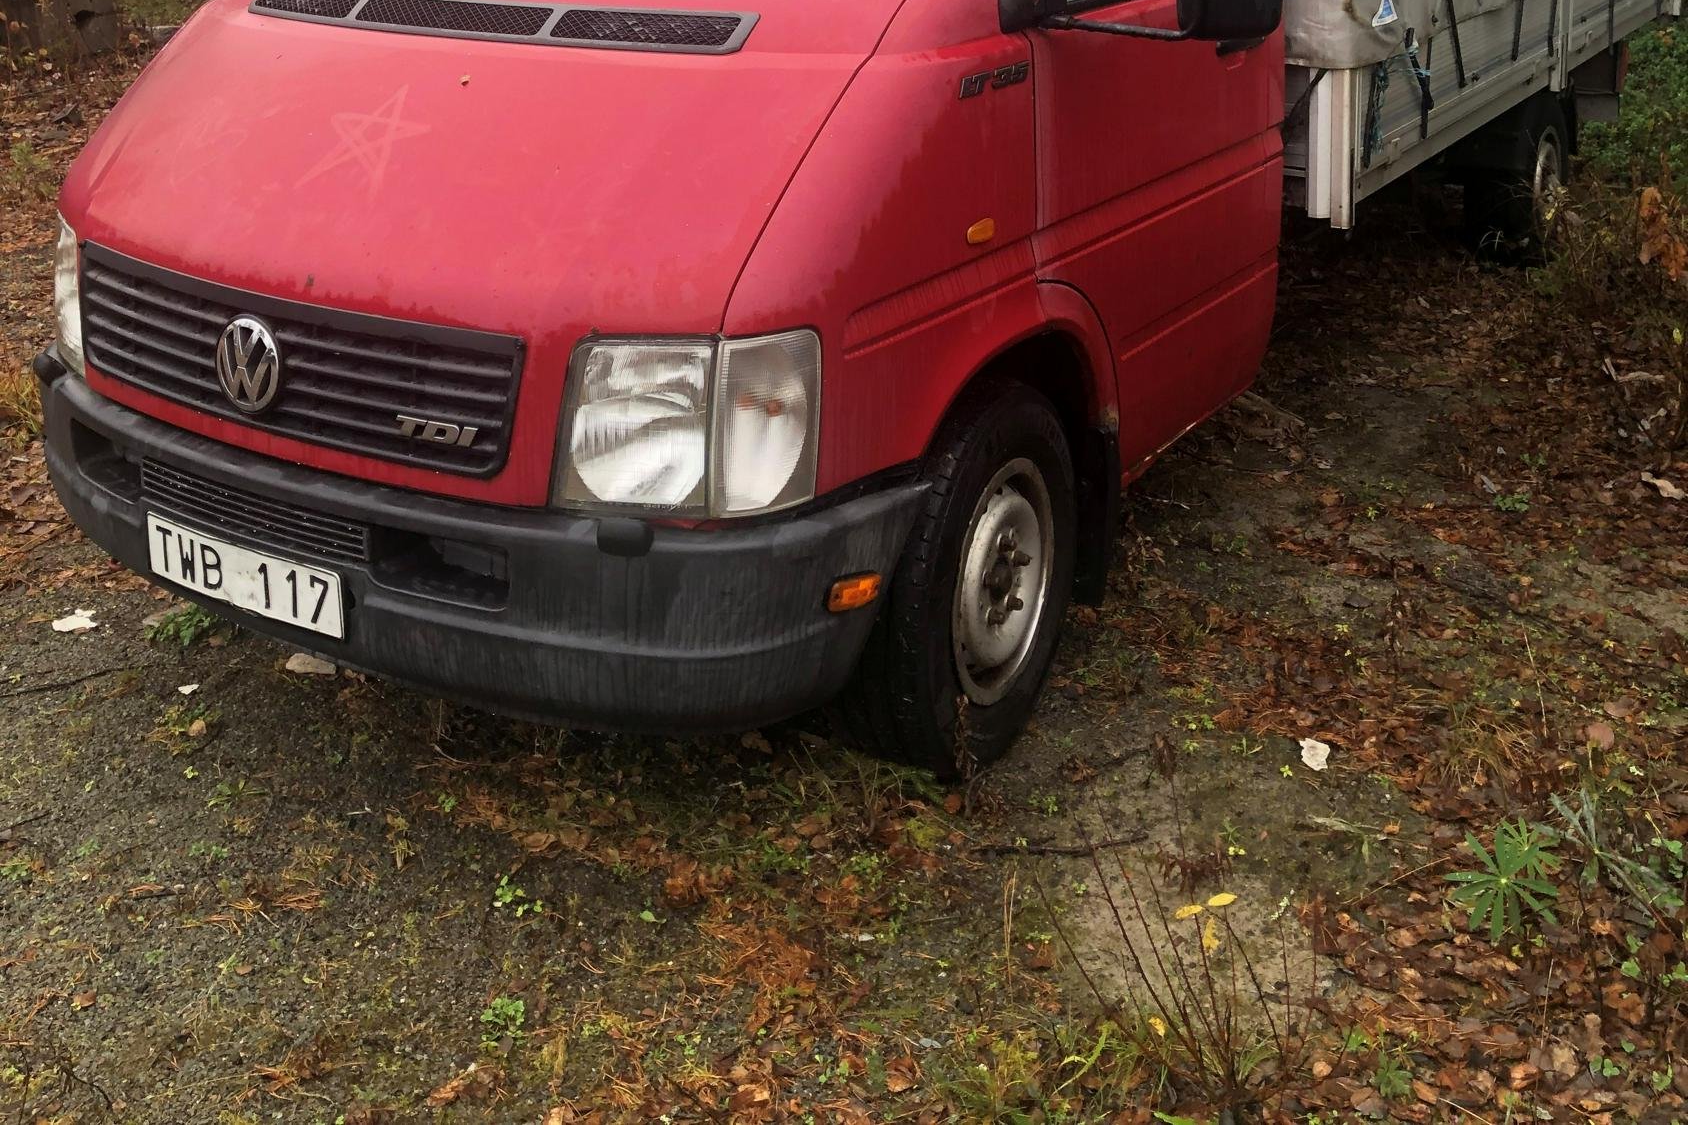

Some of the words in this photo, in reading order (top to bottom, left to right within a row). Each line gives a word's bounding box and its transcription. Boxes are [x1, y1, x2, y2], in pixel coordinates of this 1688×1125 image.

[958, 70, 992, 99] LT
[396, 414, 479, 448] TDI
[155, 524, 223, 590] TWB
[257, 561, 329, 624] 117
